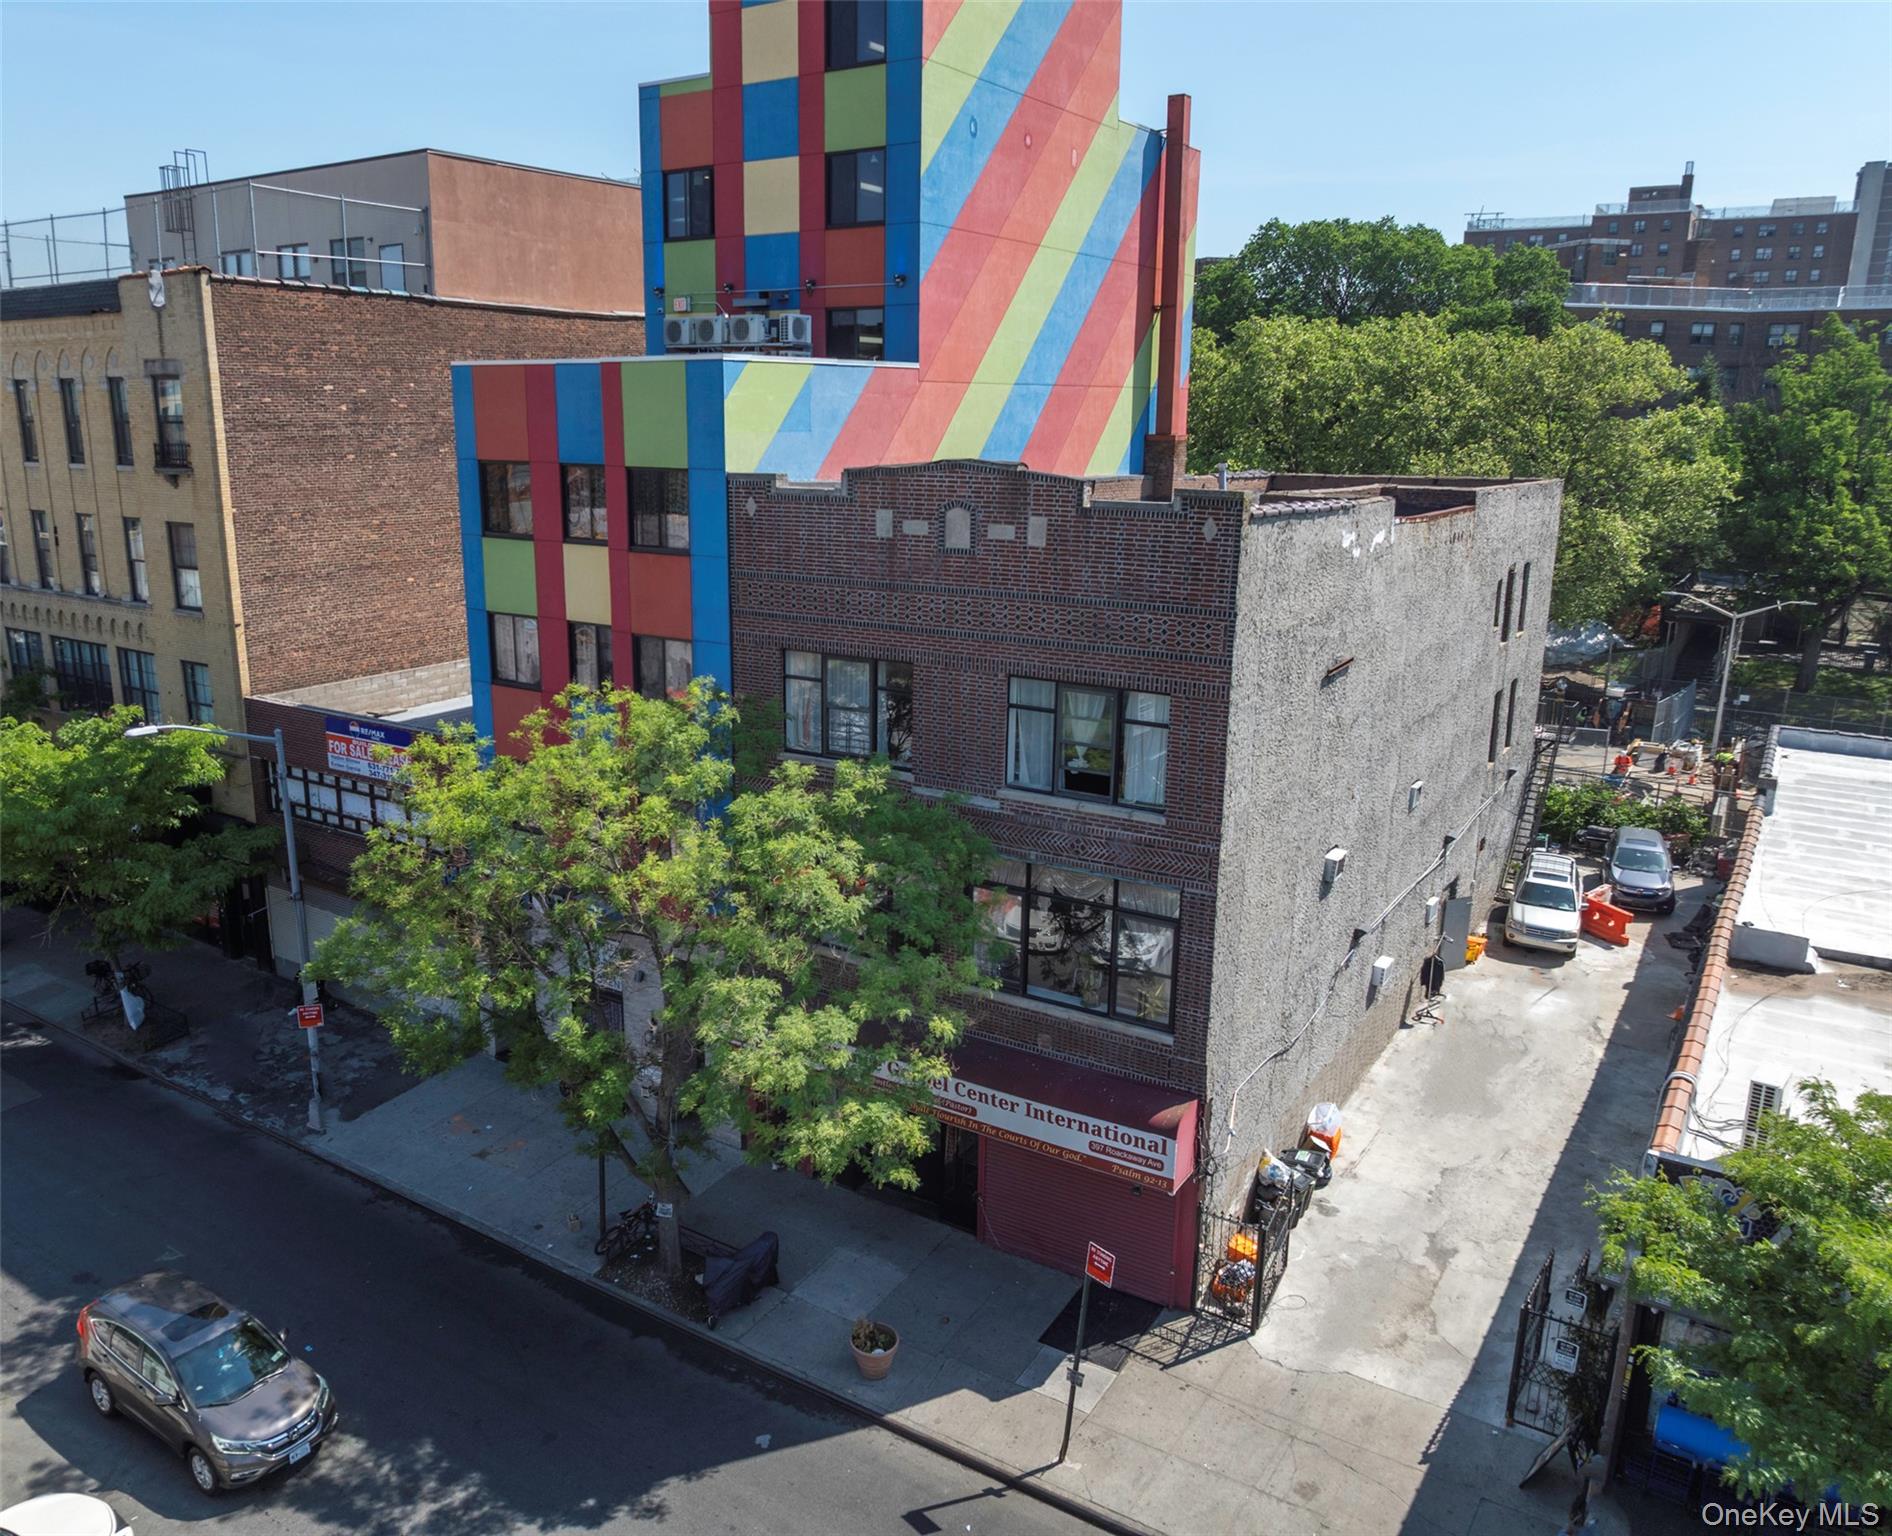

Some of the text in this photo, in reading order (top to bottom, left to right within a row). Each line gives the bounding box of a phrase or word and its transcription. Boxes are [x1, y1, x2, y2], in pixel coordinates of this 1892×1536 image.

[360, 727, 385, 739] RE/MAX
[328, 739, 348, 756] FOR
[349, 743, 373, 761] SALE
[954, 1082, 1019, 1113] Center
[1024, 1102, 1168, 1156] International
[968, 1120, 978, 1130] In
[980, 1124, 998, 1137] The
[998, 1129, 1028, 1148] Courts
[1029, 1140, 1041, 1151] Of
[1042, 1143, 1061, 1155] Our
[1111, 1163, 1142, 1180] Psalm
[1146, 1158, 1163, 1169] Ave
